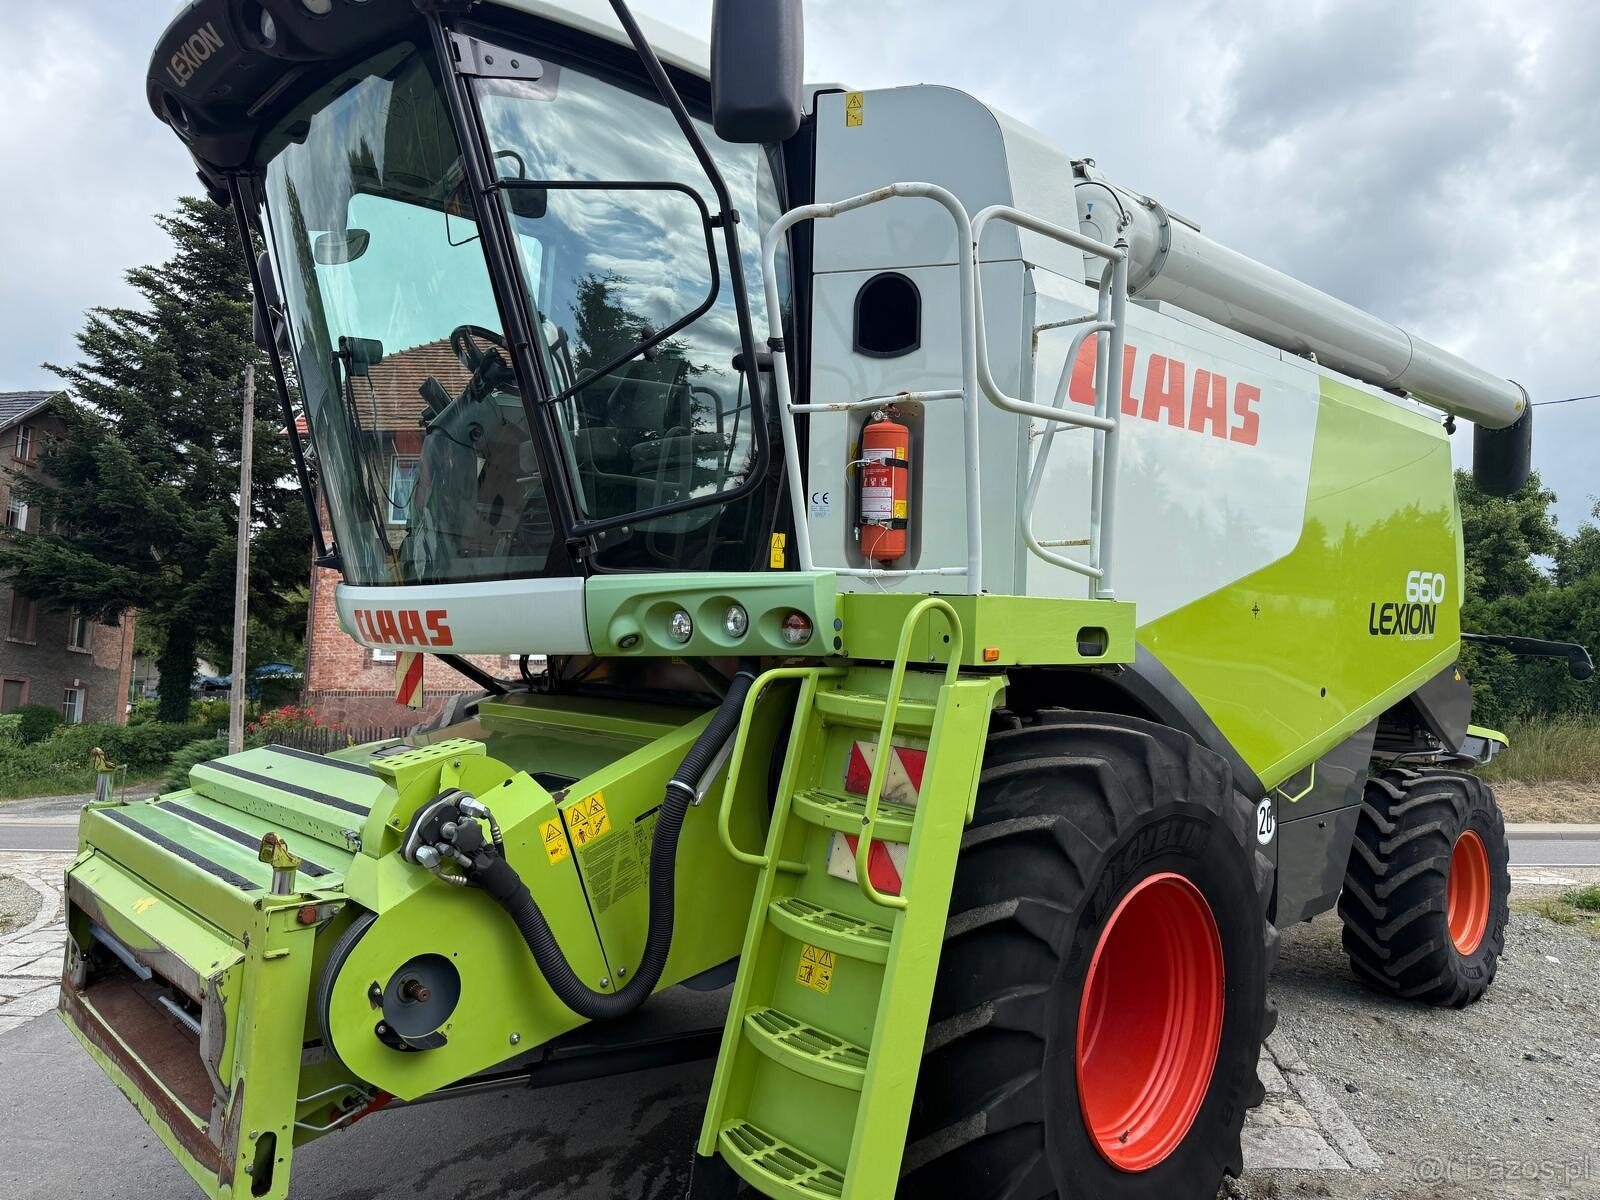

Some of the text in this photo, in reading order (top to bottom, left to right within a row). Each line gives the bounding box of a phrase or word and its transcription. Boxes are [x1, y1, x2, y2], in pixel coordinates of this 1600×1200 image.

[166, 21, 225, 87] LEXION
[811, 492, 829, 505] CE
[1406, 570, 1446, 604] 660
[354, 609, 454, 647] CLAAS
[1368, 602, 1437, 635] LEXION
